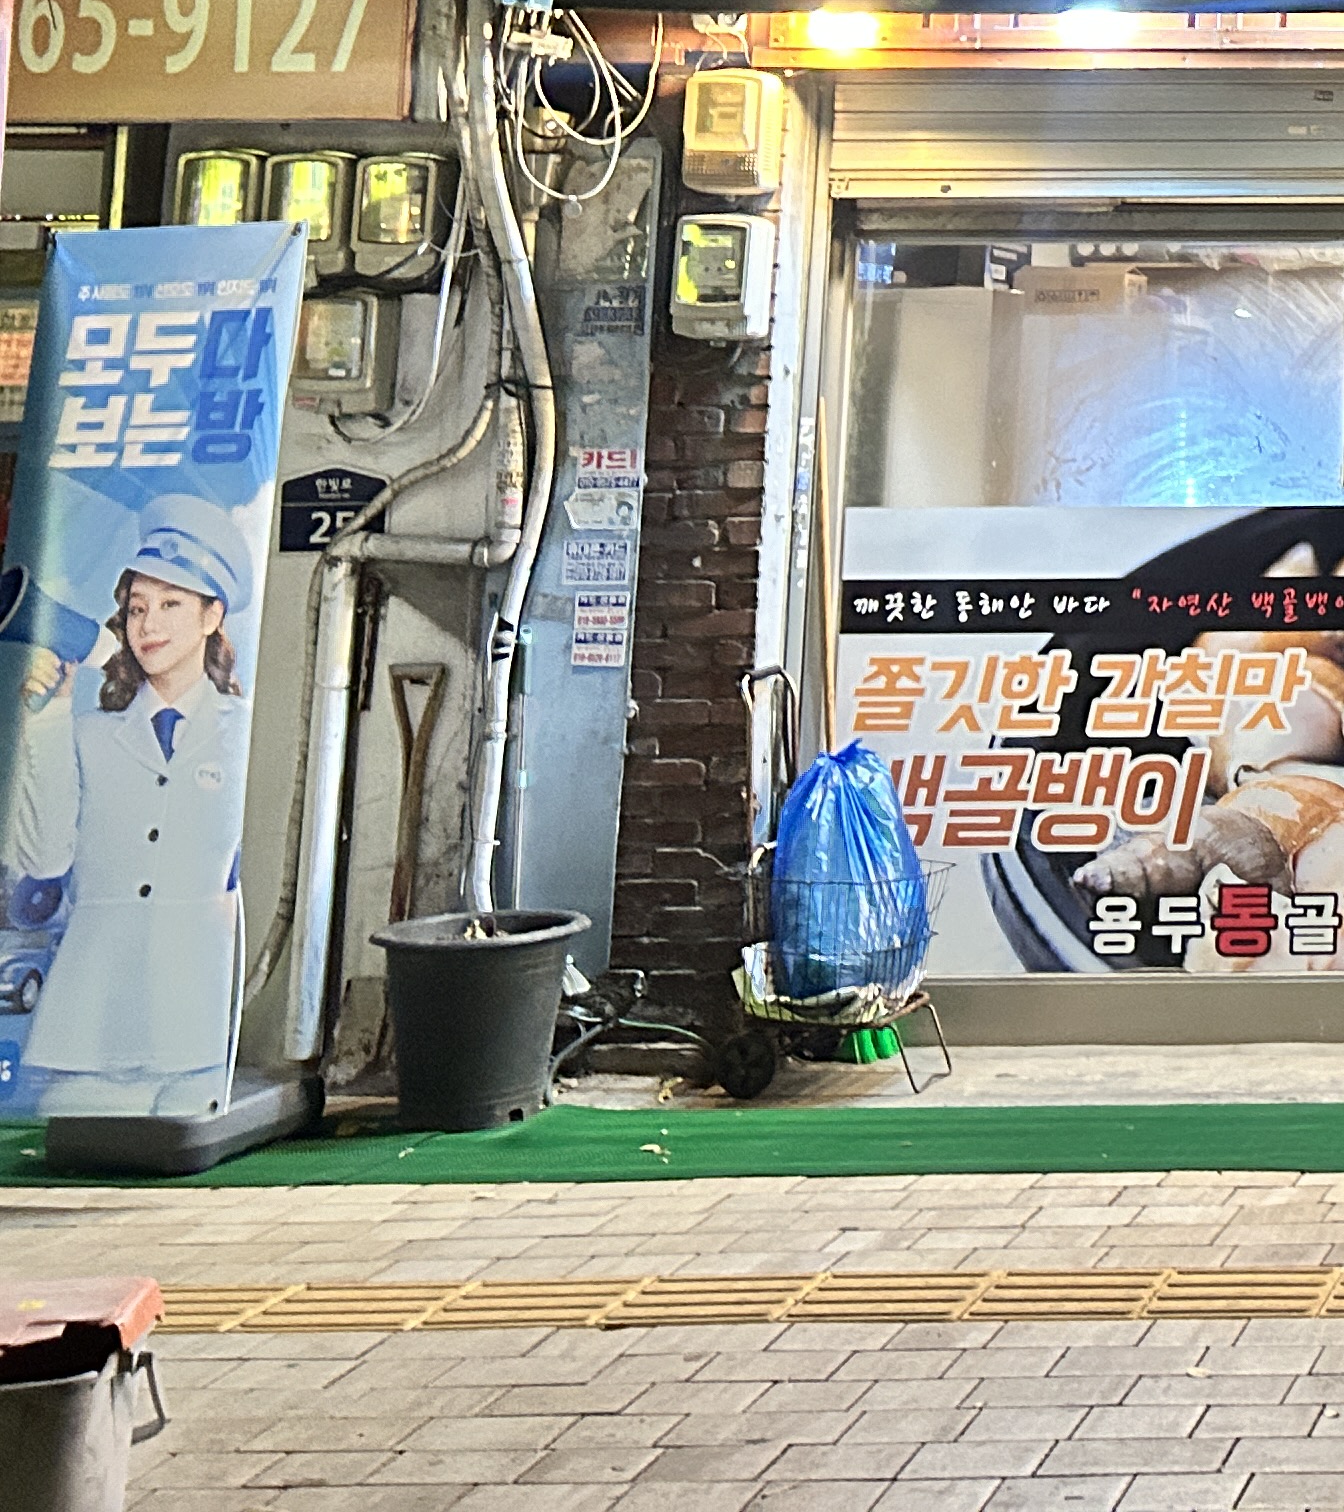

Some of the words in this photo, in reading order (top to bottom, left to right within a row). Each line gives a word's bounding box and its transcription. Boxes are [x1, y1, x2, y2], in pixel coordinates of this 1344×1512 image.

[853, 591, 938, 623] 깨끗한
[955, 590, 1035, 623] 동해안
[1053, 594, 1111, 615] 바다
[852, 653, 1078, 733] 쫄깃한
[1090, 652, 1309, 733] 감칠맛
